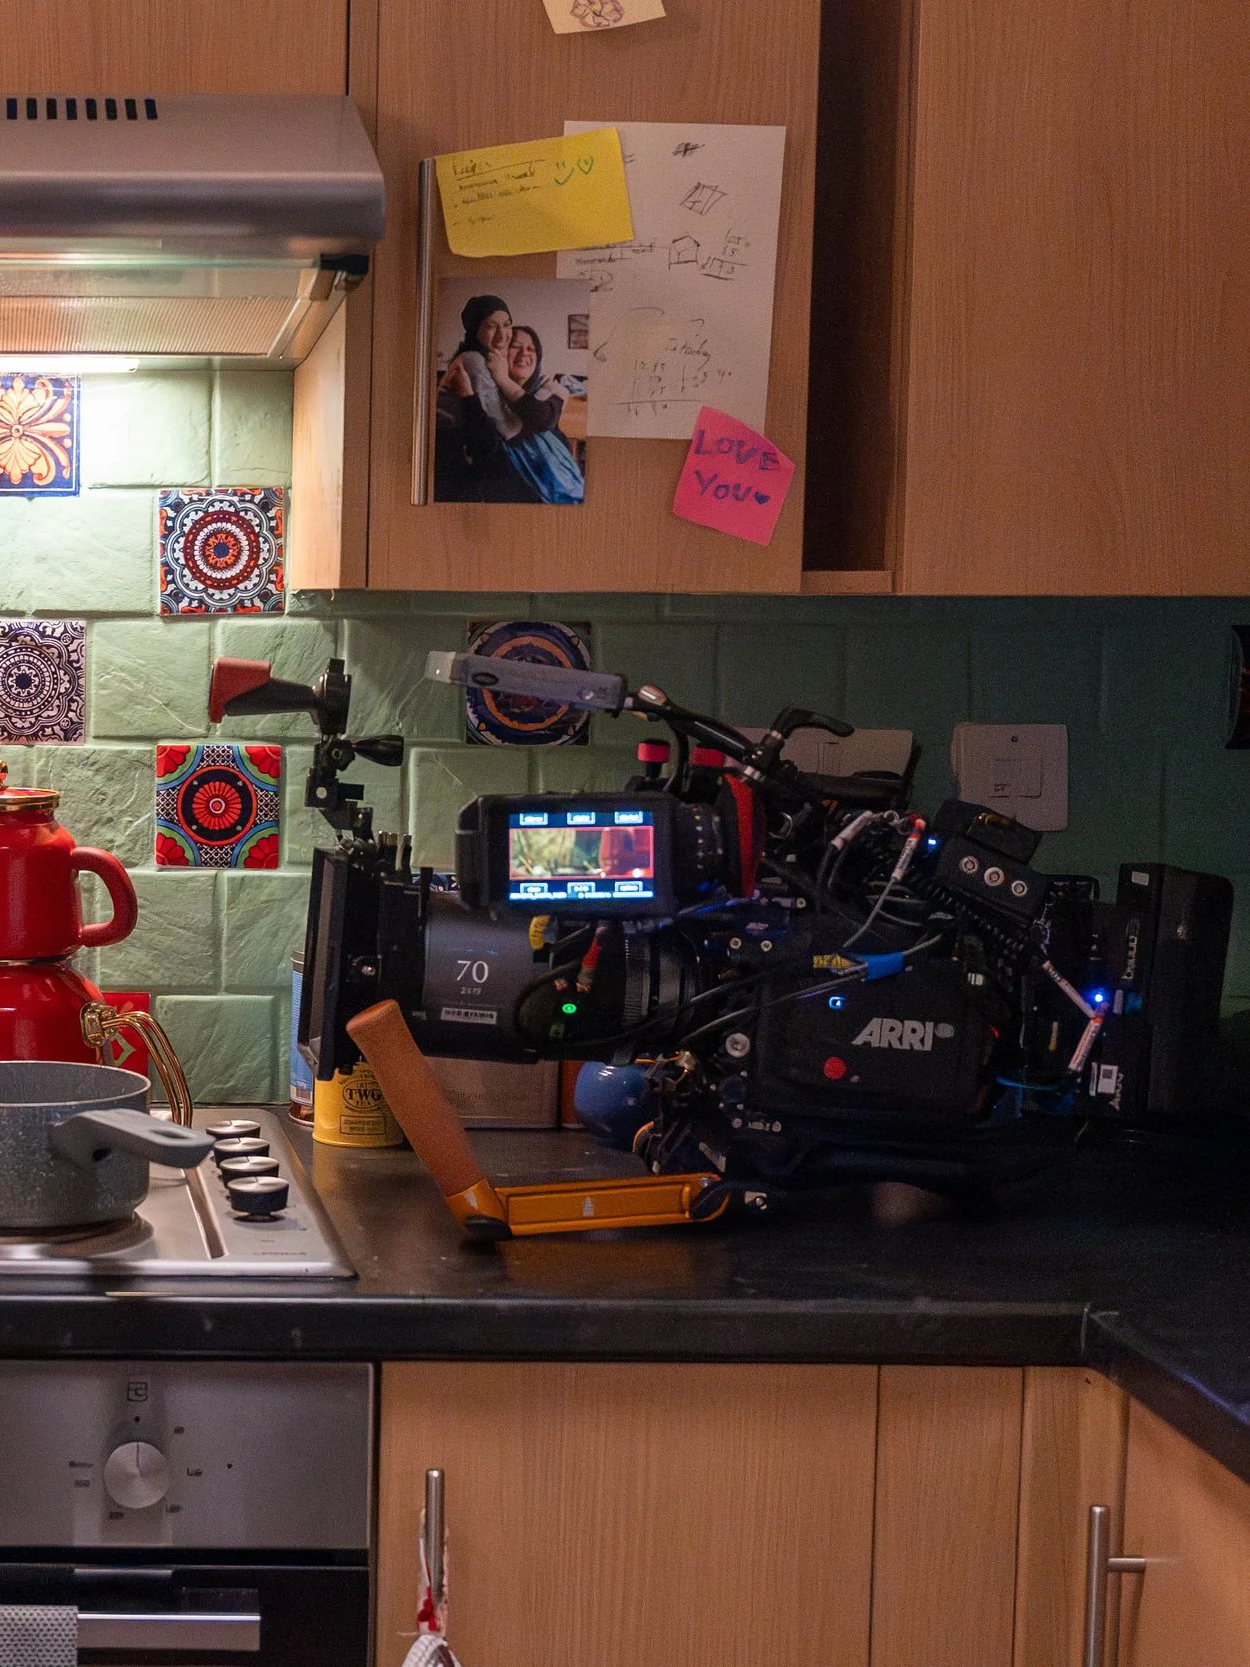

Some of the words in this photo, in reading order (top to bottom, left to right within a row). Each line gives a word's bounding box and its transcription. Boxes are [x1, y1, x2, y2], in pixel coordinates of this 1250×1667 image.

[694, 429, 782, 471] LOVE
[693, 469, 752, 502] YOU
[456, 959, 489, 984] 70
[851, 1017, 934, 1051] ARRI
